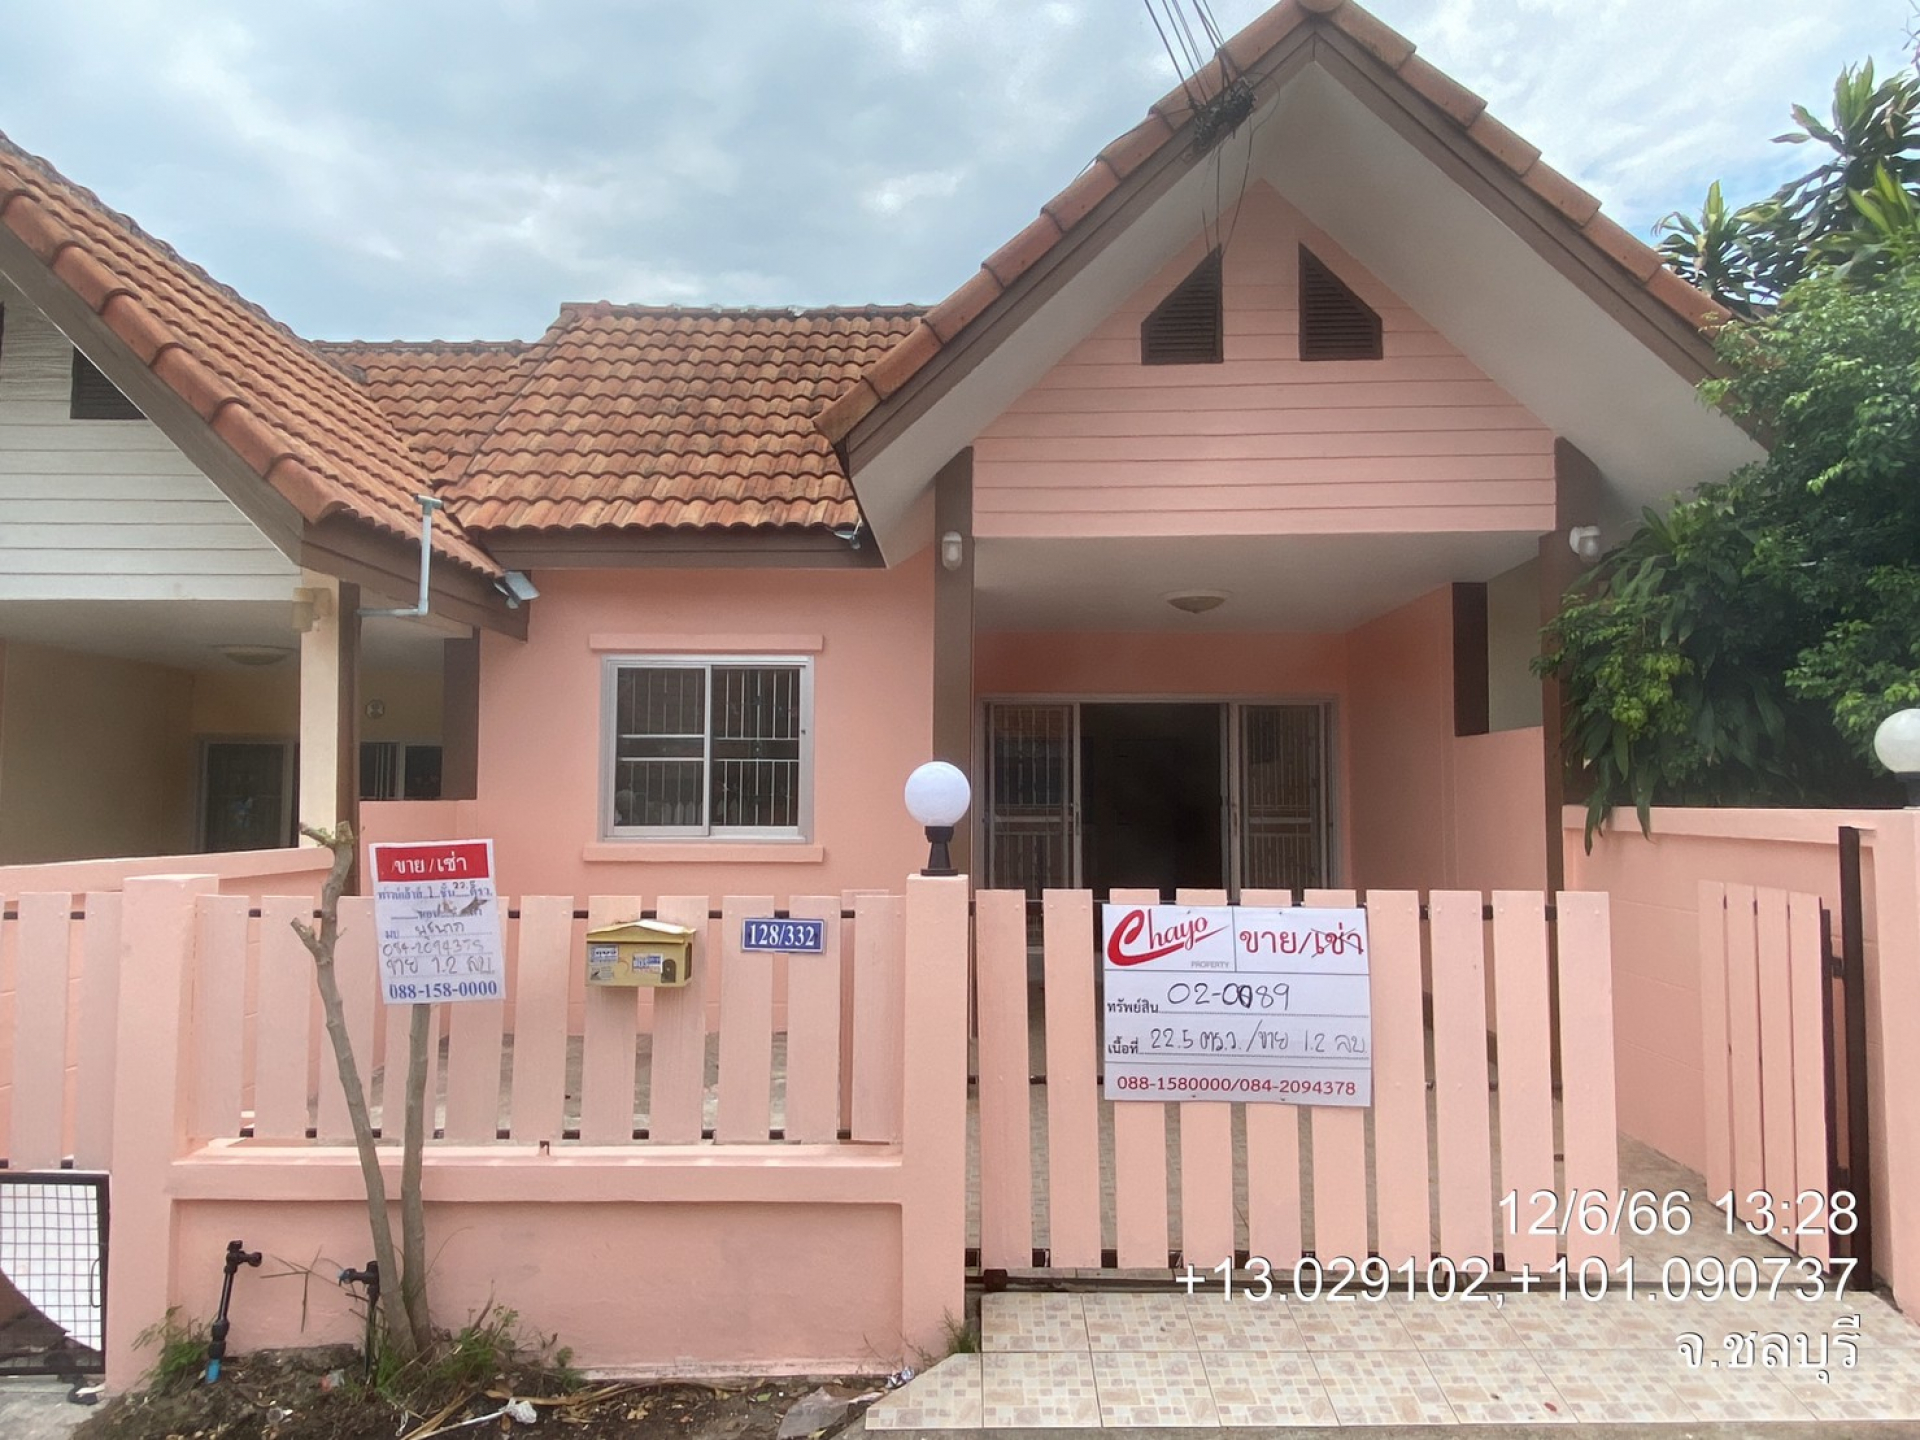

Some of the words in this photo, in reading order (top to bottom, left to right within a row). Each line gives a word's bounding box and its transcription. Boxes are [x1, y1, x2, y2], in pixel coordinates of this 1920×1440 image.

[749, 924, 815, 946] 128/332
[1107, 909, 1215, 966] Chayo
[389, 981, 497, 999] 088-158-0000
[1107, 999, 1159, 1014] ทรัพย์สิน
[1108, 1036, 1139, 1055] เนื้อที่
[1150, 1028, 1194, 1050] 22.5
[1117, 1076, 1356, 1095] 088-1580000/084-2094378
